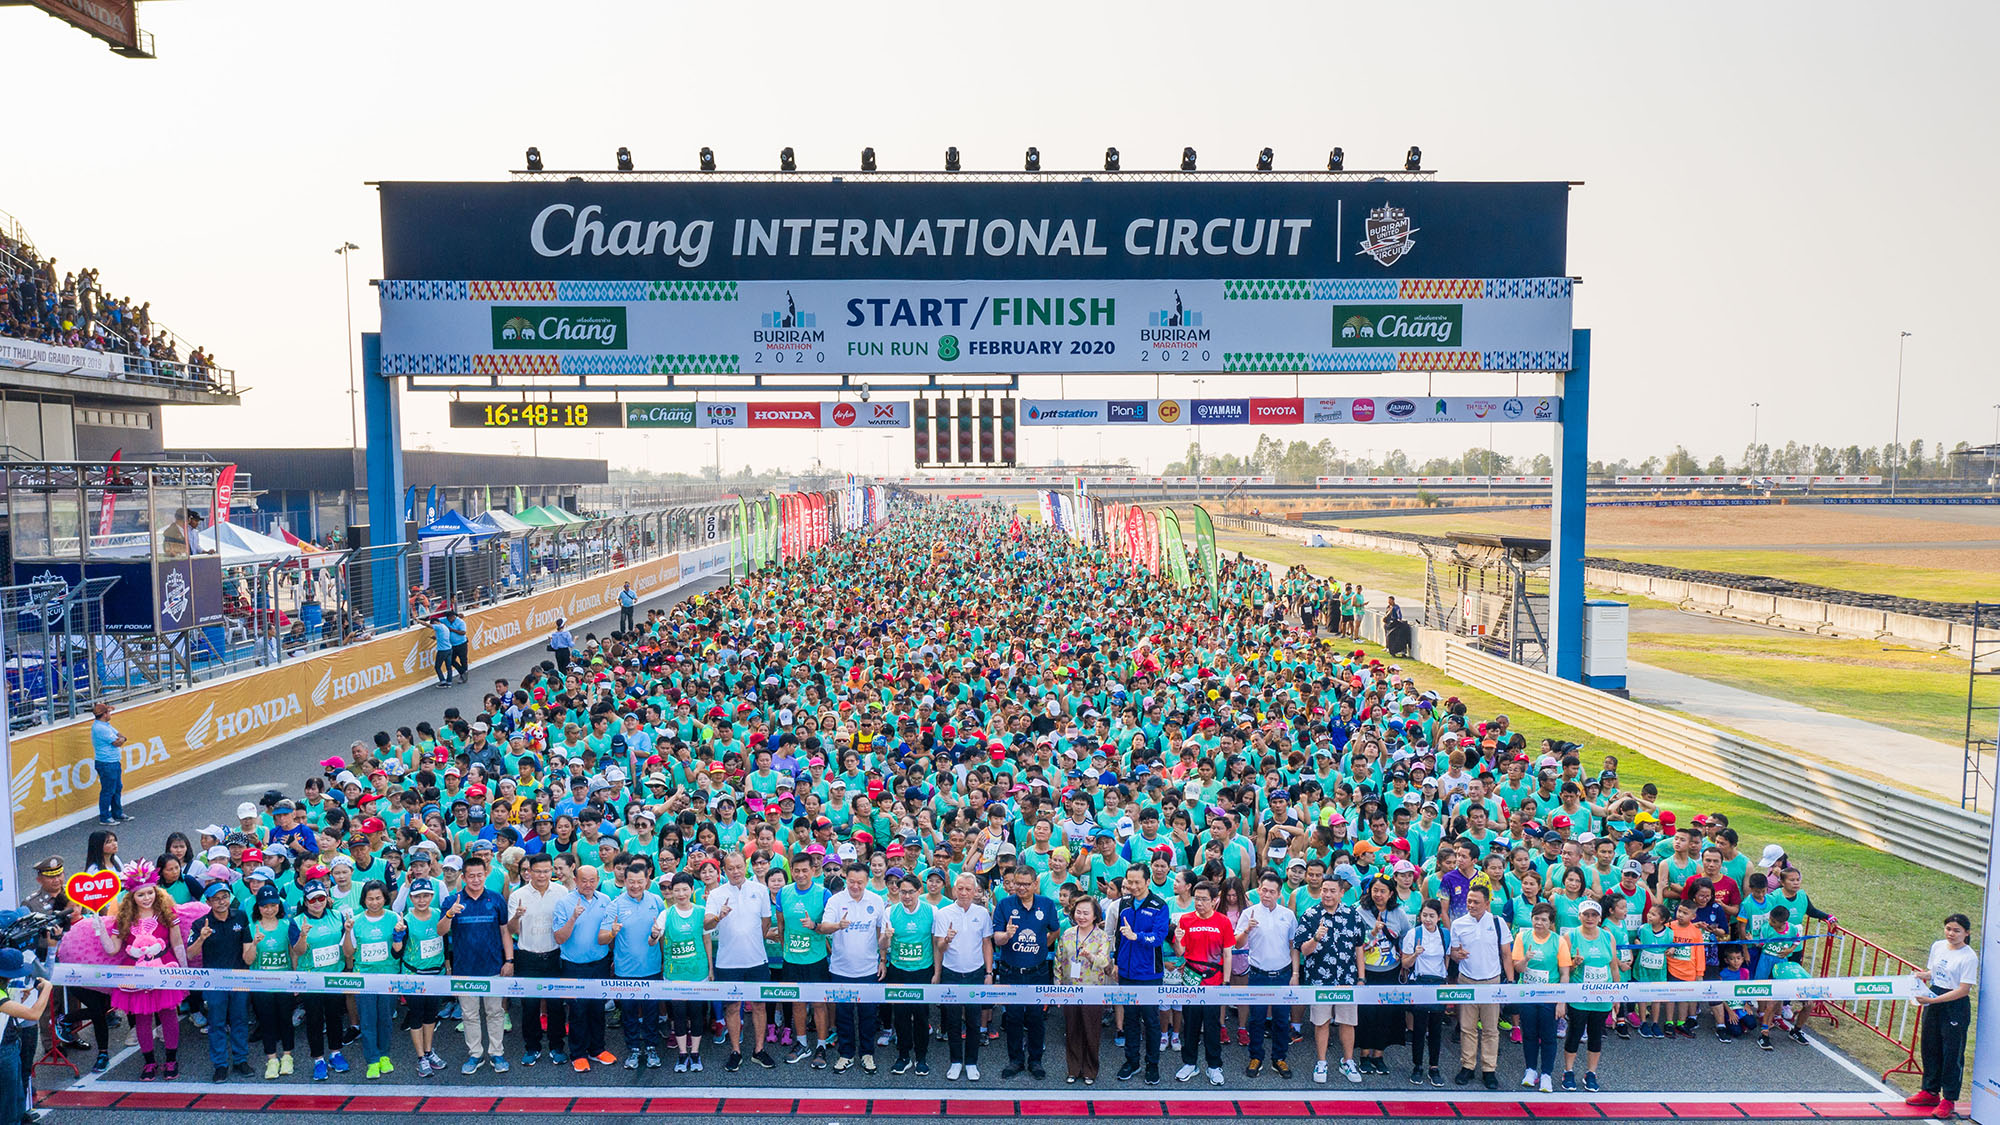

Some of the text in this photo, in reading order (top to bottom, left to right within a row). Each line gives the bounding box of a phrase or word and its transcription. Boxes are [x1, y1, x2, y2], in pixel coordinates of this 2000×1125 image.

[1369, 220, 1408, 236] BURIRAM
[530, 203, 1312, 268] Chang INTERNATIONAL CIRCUIT
[846, 298, 1116, 330] START/FINISH
[538, 316, 617, 346] Chang
[1376, 314, 1452, 343] Chang
[753, 330, 825, 343] BURIRAM
[1141, 329, 1211, 342] BURIRAM
[848, 334, 1116, 362] FUN RUN 8 FEBRUARY 2020
[1153, 341, 1198, 349] MARATHON
[13, 347, 47, 362] THAILAND
[48, 353, 71, 366] GRAND
[71, 356, 87, 368] PRIX
[87, 358, 102, 369] 2019
[484, 404, 588, 426] 16:48:18
[650, 407, 693, 424] Chang
[754, 410, 815, 420] HONDA
[1160, 406, 1178, 417] CP
[1209, 405, 1242, 415] YAMAHA
[1256, 407, 1297, 416] TOYOTA
[707, 516, 715, 539] 200
[576, 593, 602, 614] HONDA
[535, 606, 566, 628] HONDA
[483, 620, 522, 646] HONDA
[1471, 625, 1477, 635] F
[333, 662, 397, 700] HONDA
[216, 694, 302, 741] HONDA
[41, 736, 170, 801] HODA
[75, 878, 113, 892] LOVE
[790, 939, 810, 947] 70736
[1012, 942, 1040, 955] Chang
[315, 951, 339, 962] 80239
[363, 948, 387, 957] 52795
[672, 945, 695, 955] 53386
[262, 957, 287, 965] 71214
[338, 977, 362, 987] Chang
[464, 981, 488, 991] Chang
[1867, 984, 1890, 992] Chang
[773, 988, 797, 997] Chang
[897, 990, 921, 999] Chang
[1328, 992, 1351, 1001] Chang
[1449, 991, 1472, 999] Chang
[1746, 986, 1769, 995] Chang
